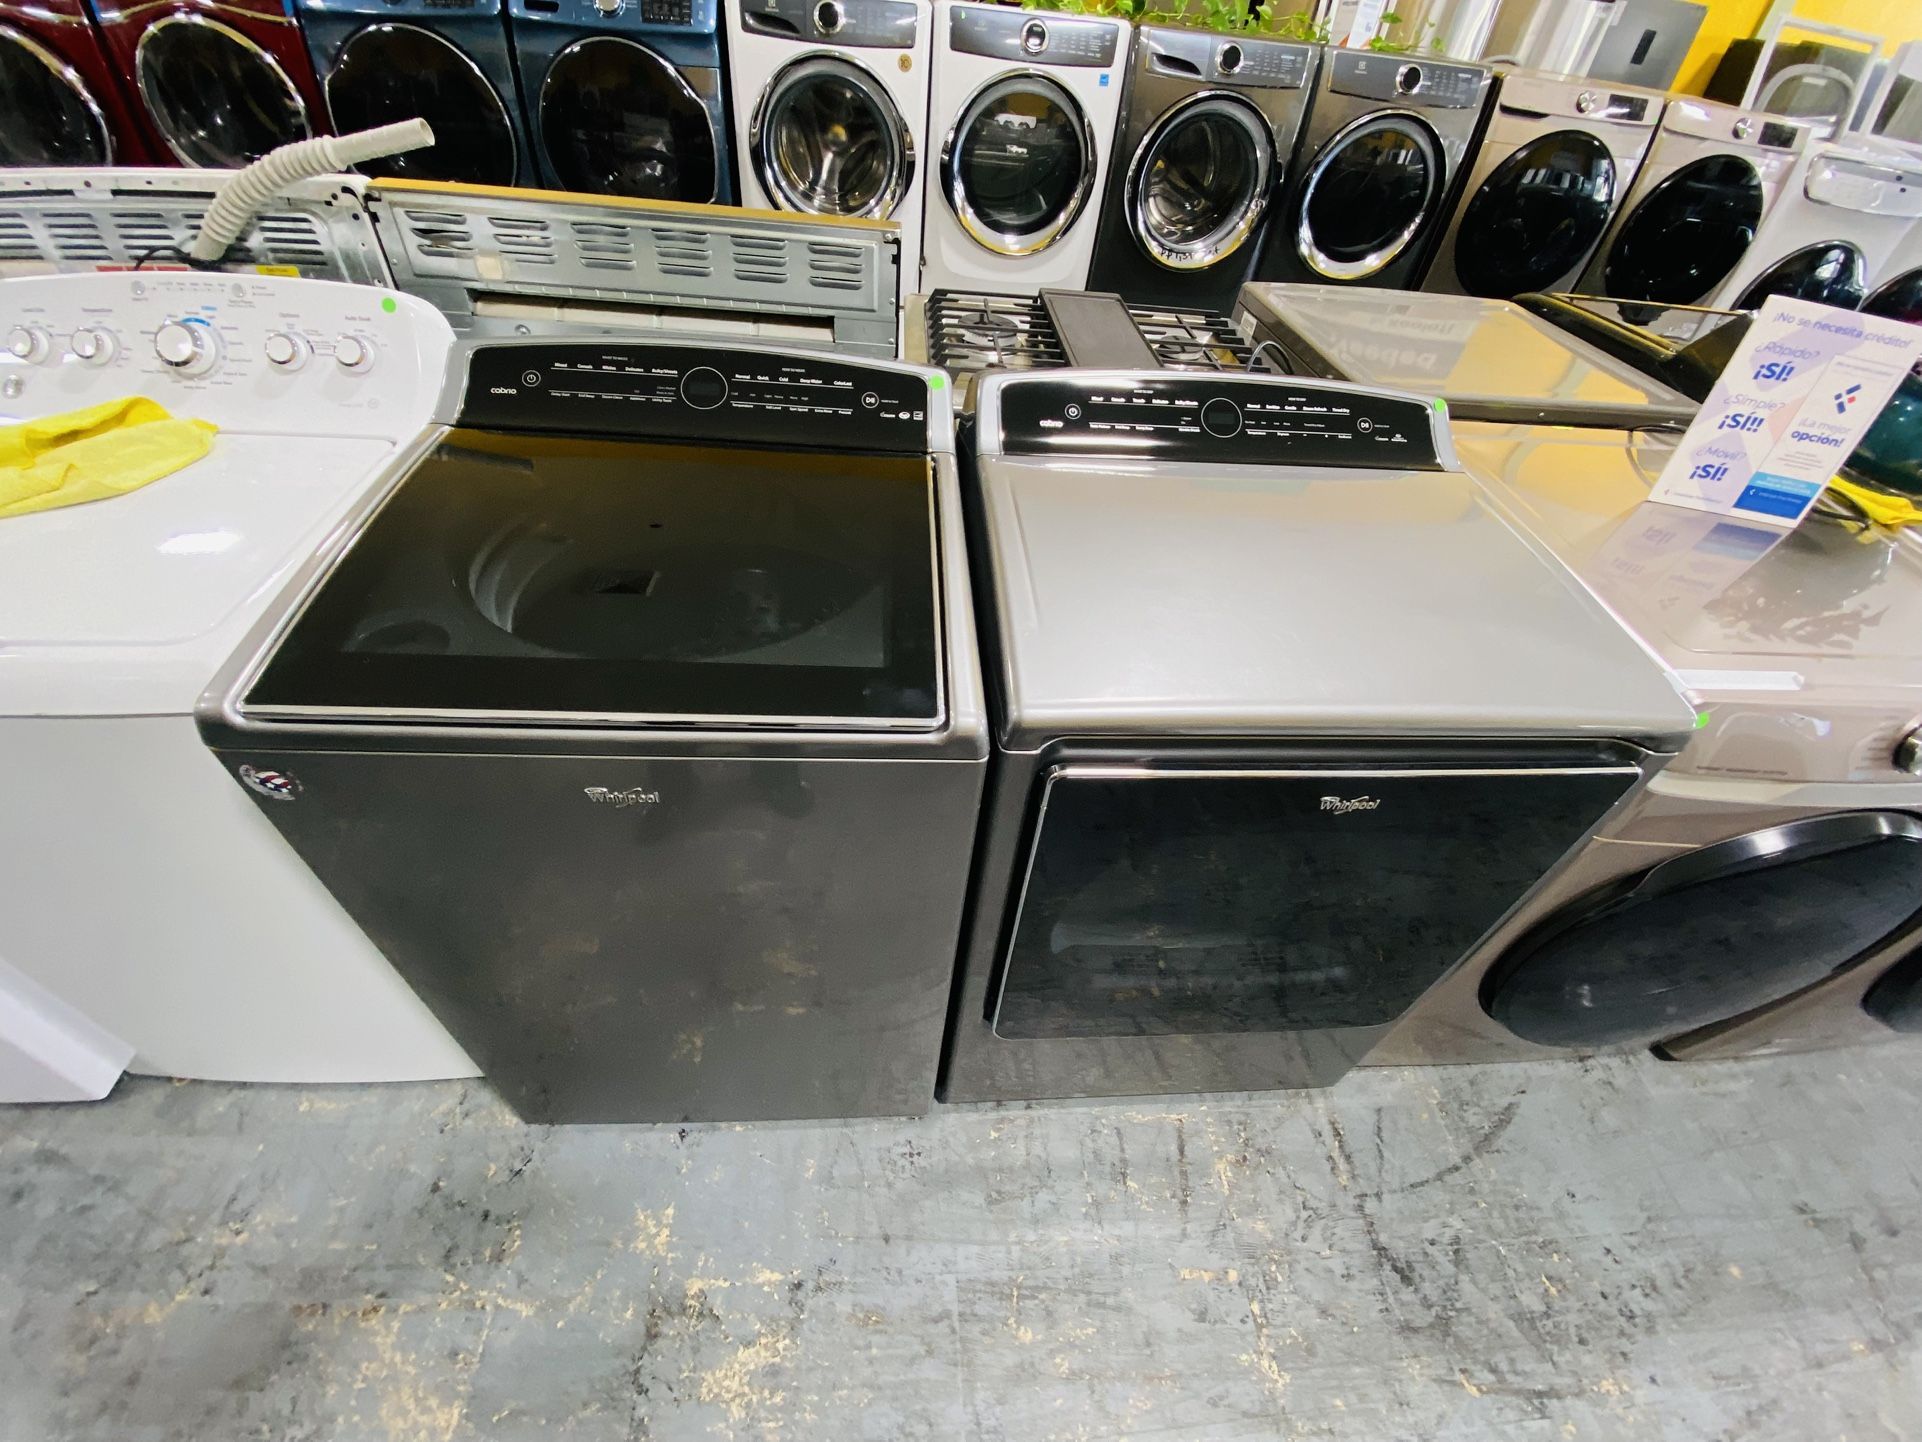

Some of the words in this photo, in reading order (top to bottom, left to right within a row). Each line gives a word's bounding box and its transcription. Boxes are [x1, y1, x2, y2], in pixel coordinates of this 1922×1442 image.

[1813, 321, 1863, 339] necesita
[1752, 361, 1795, 382] ¡SÍ!
[1718, 411, 1765, 433] ¡SÍ!!
[1791, 430, 1845, 448] opción!
[1689, 462, 1729, 482] ¡SÍ!
[584, 787, 660, 808] Whirlpool
[1320, 795, 1381, 815] Whirlpool
